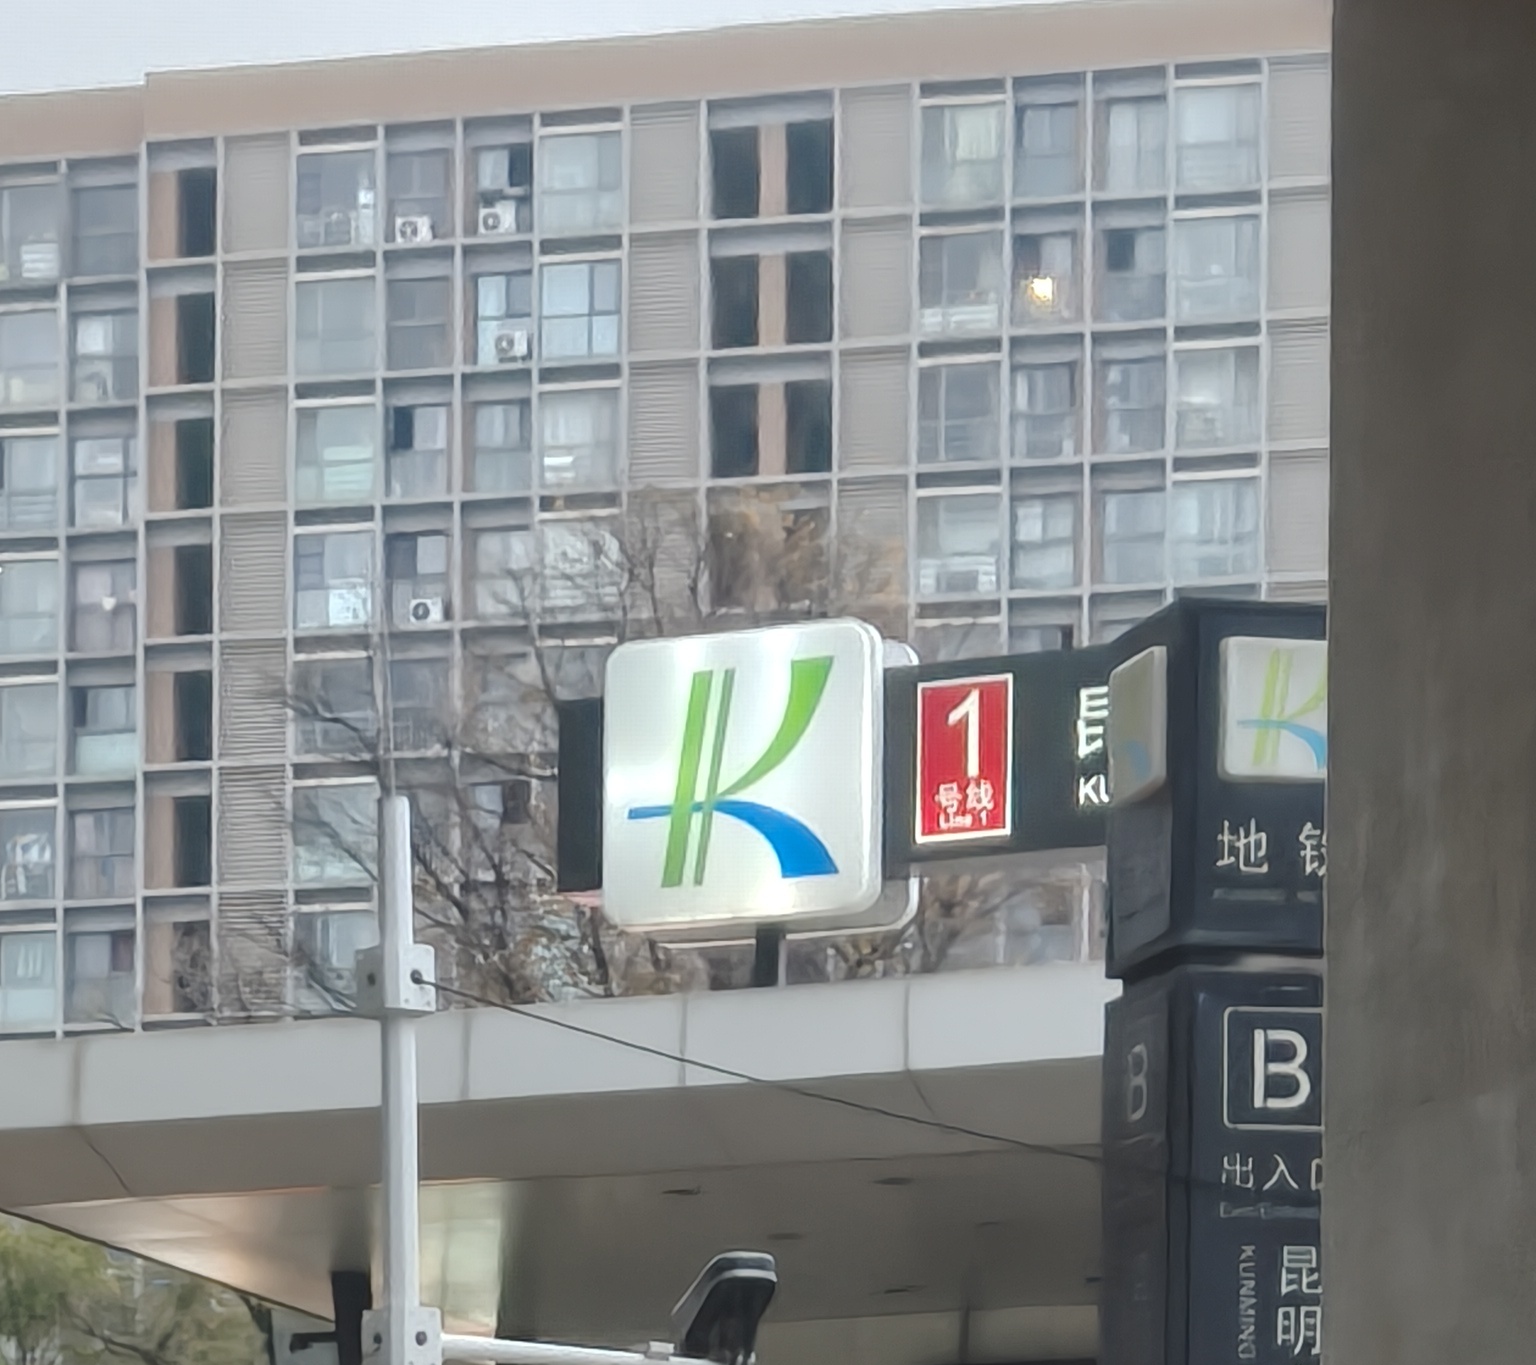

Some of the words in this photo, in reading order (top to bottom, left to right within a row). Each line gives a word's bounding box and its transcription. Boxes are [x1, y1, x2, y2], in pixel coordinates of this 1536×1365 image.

[947, 687, 981, 778] 1
[933, 778, 995, 811] 号线
[1254, 1029, 1311, 1109] B
